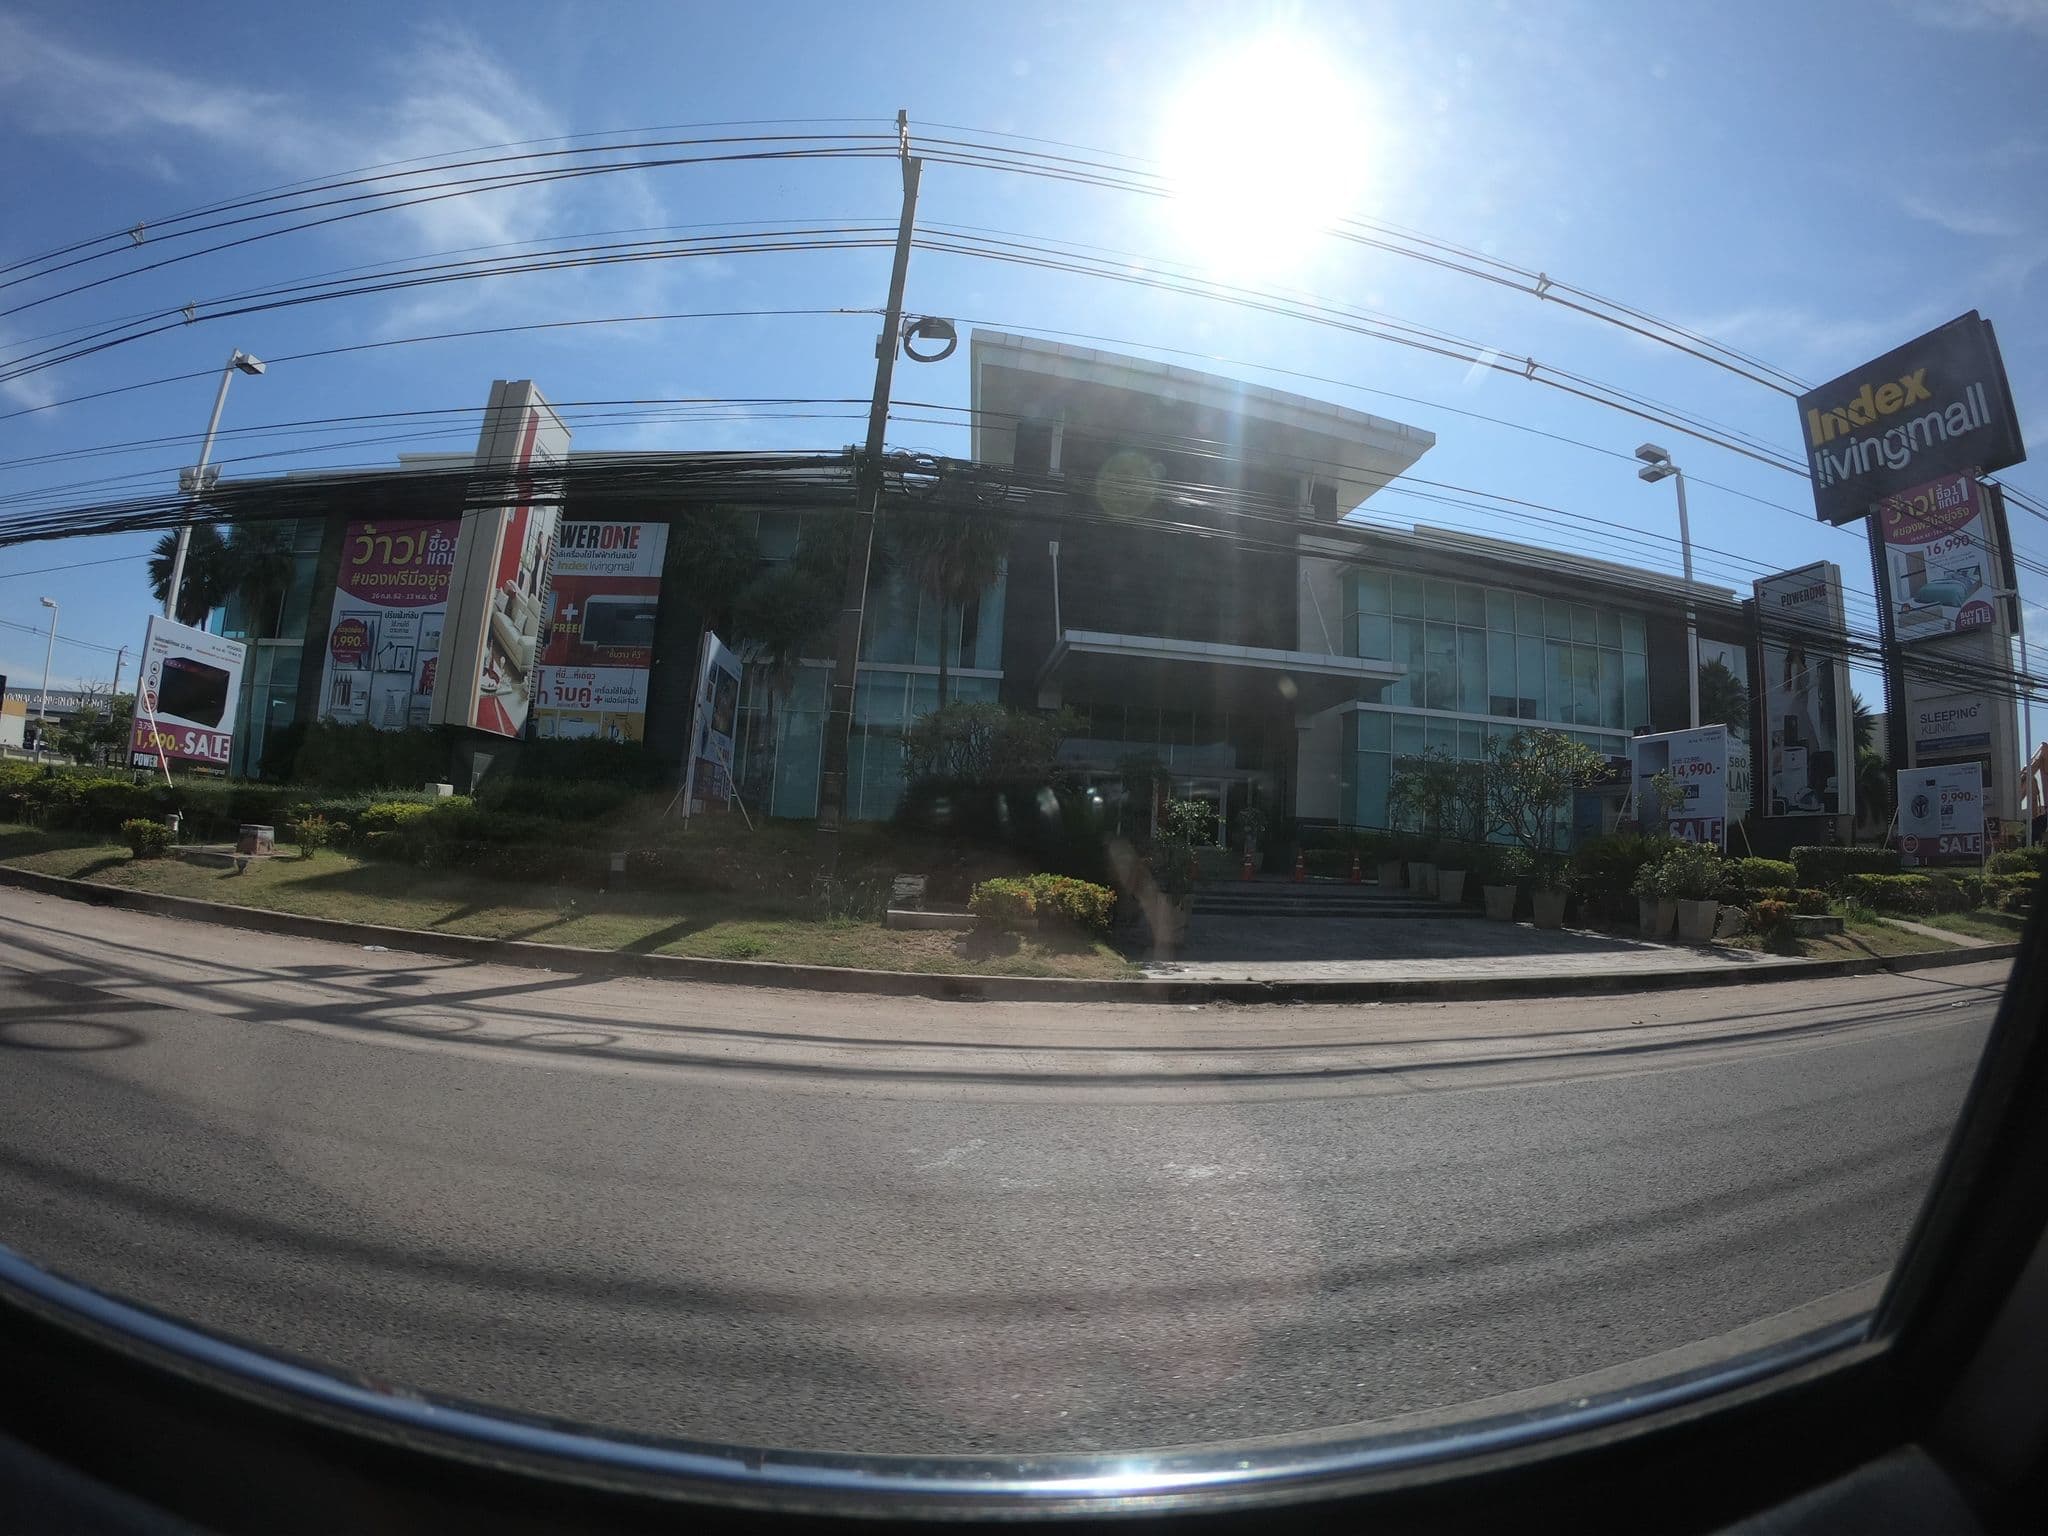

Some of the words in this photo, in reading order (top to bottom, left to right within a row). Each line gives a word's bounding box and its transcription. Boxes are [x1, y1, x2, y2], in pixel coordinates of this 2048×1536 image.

[1807, 367, 1932, 448] Index
[1814, 382, 1992, 488] livingmall
[351, 524, 428, 565] ว้าว!
[554, 680, 593, 709] จับคู่
[1920, 706, 1978, 724] SLEEPING
[136, 728, 184, 752] 1,990.-
[184, 731, 230, 761] SALE
[1672, 762, 1720, 779] 14,990.-
[1941, 791, 1978, 804] 9,990.-
[1939, 834, 1982, 854] SALE
